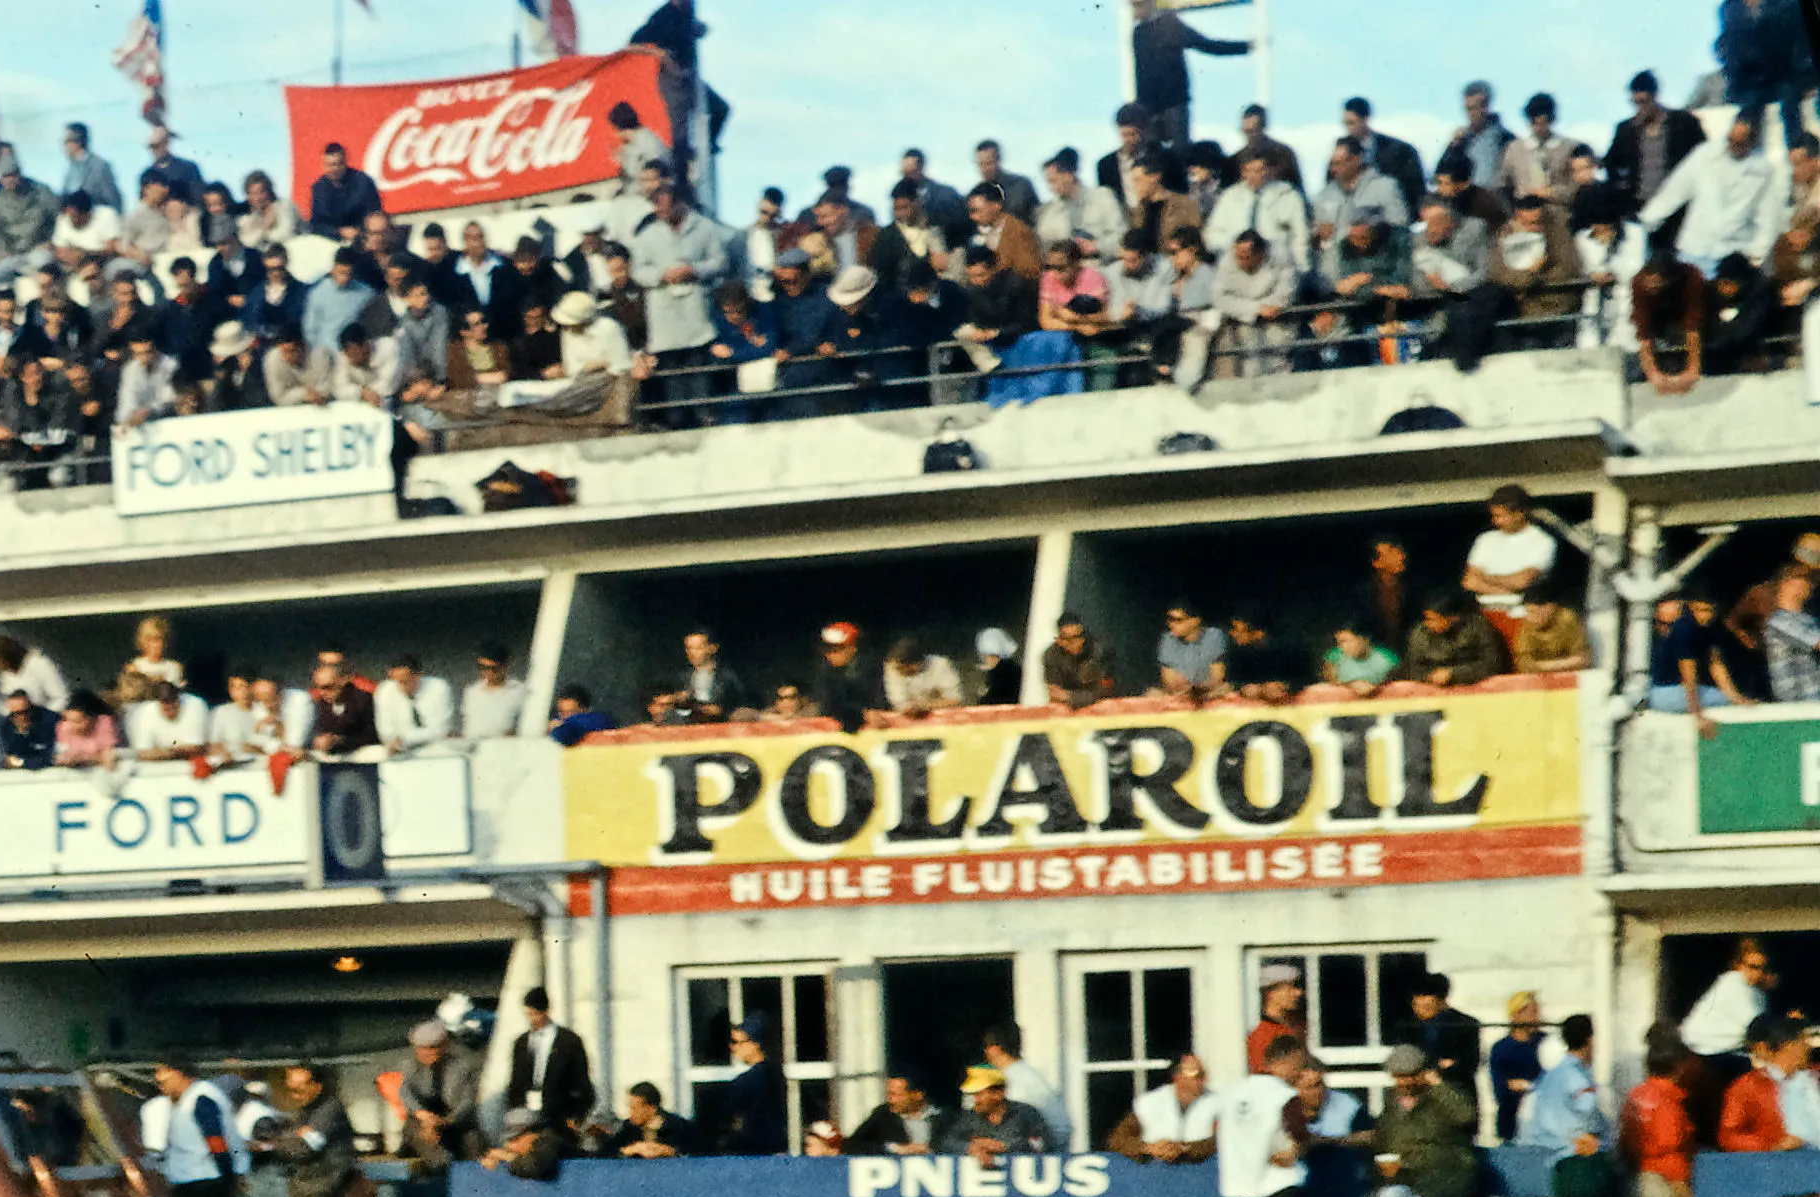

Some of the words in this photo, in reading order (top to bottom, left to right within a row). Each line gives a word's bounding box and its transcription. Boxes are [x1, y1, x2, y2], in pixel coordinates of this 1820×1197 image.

[127, 438, 236, 491] FORD
[252, 421, 382, 478] SHELBY
[657, 709, 1491, 855] POLAROIL
[56, 792, 261, 852] FORD
[730, 865, 893, 903] HUILE
[912, 843, 1384, 896] FLUISTABILISÉE
